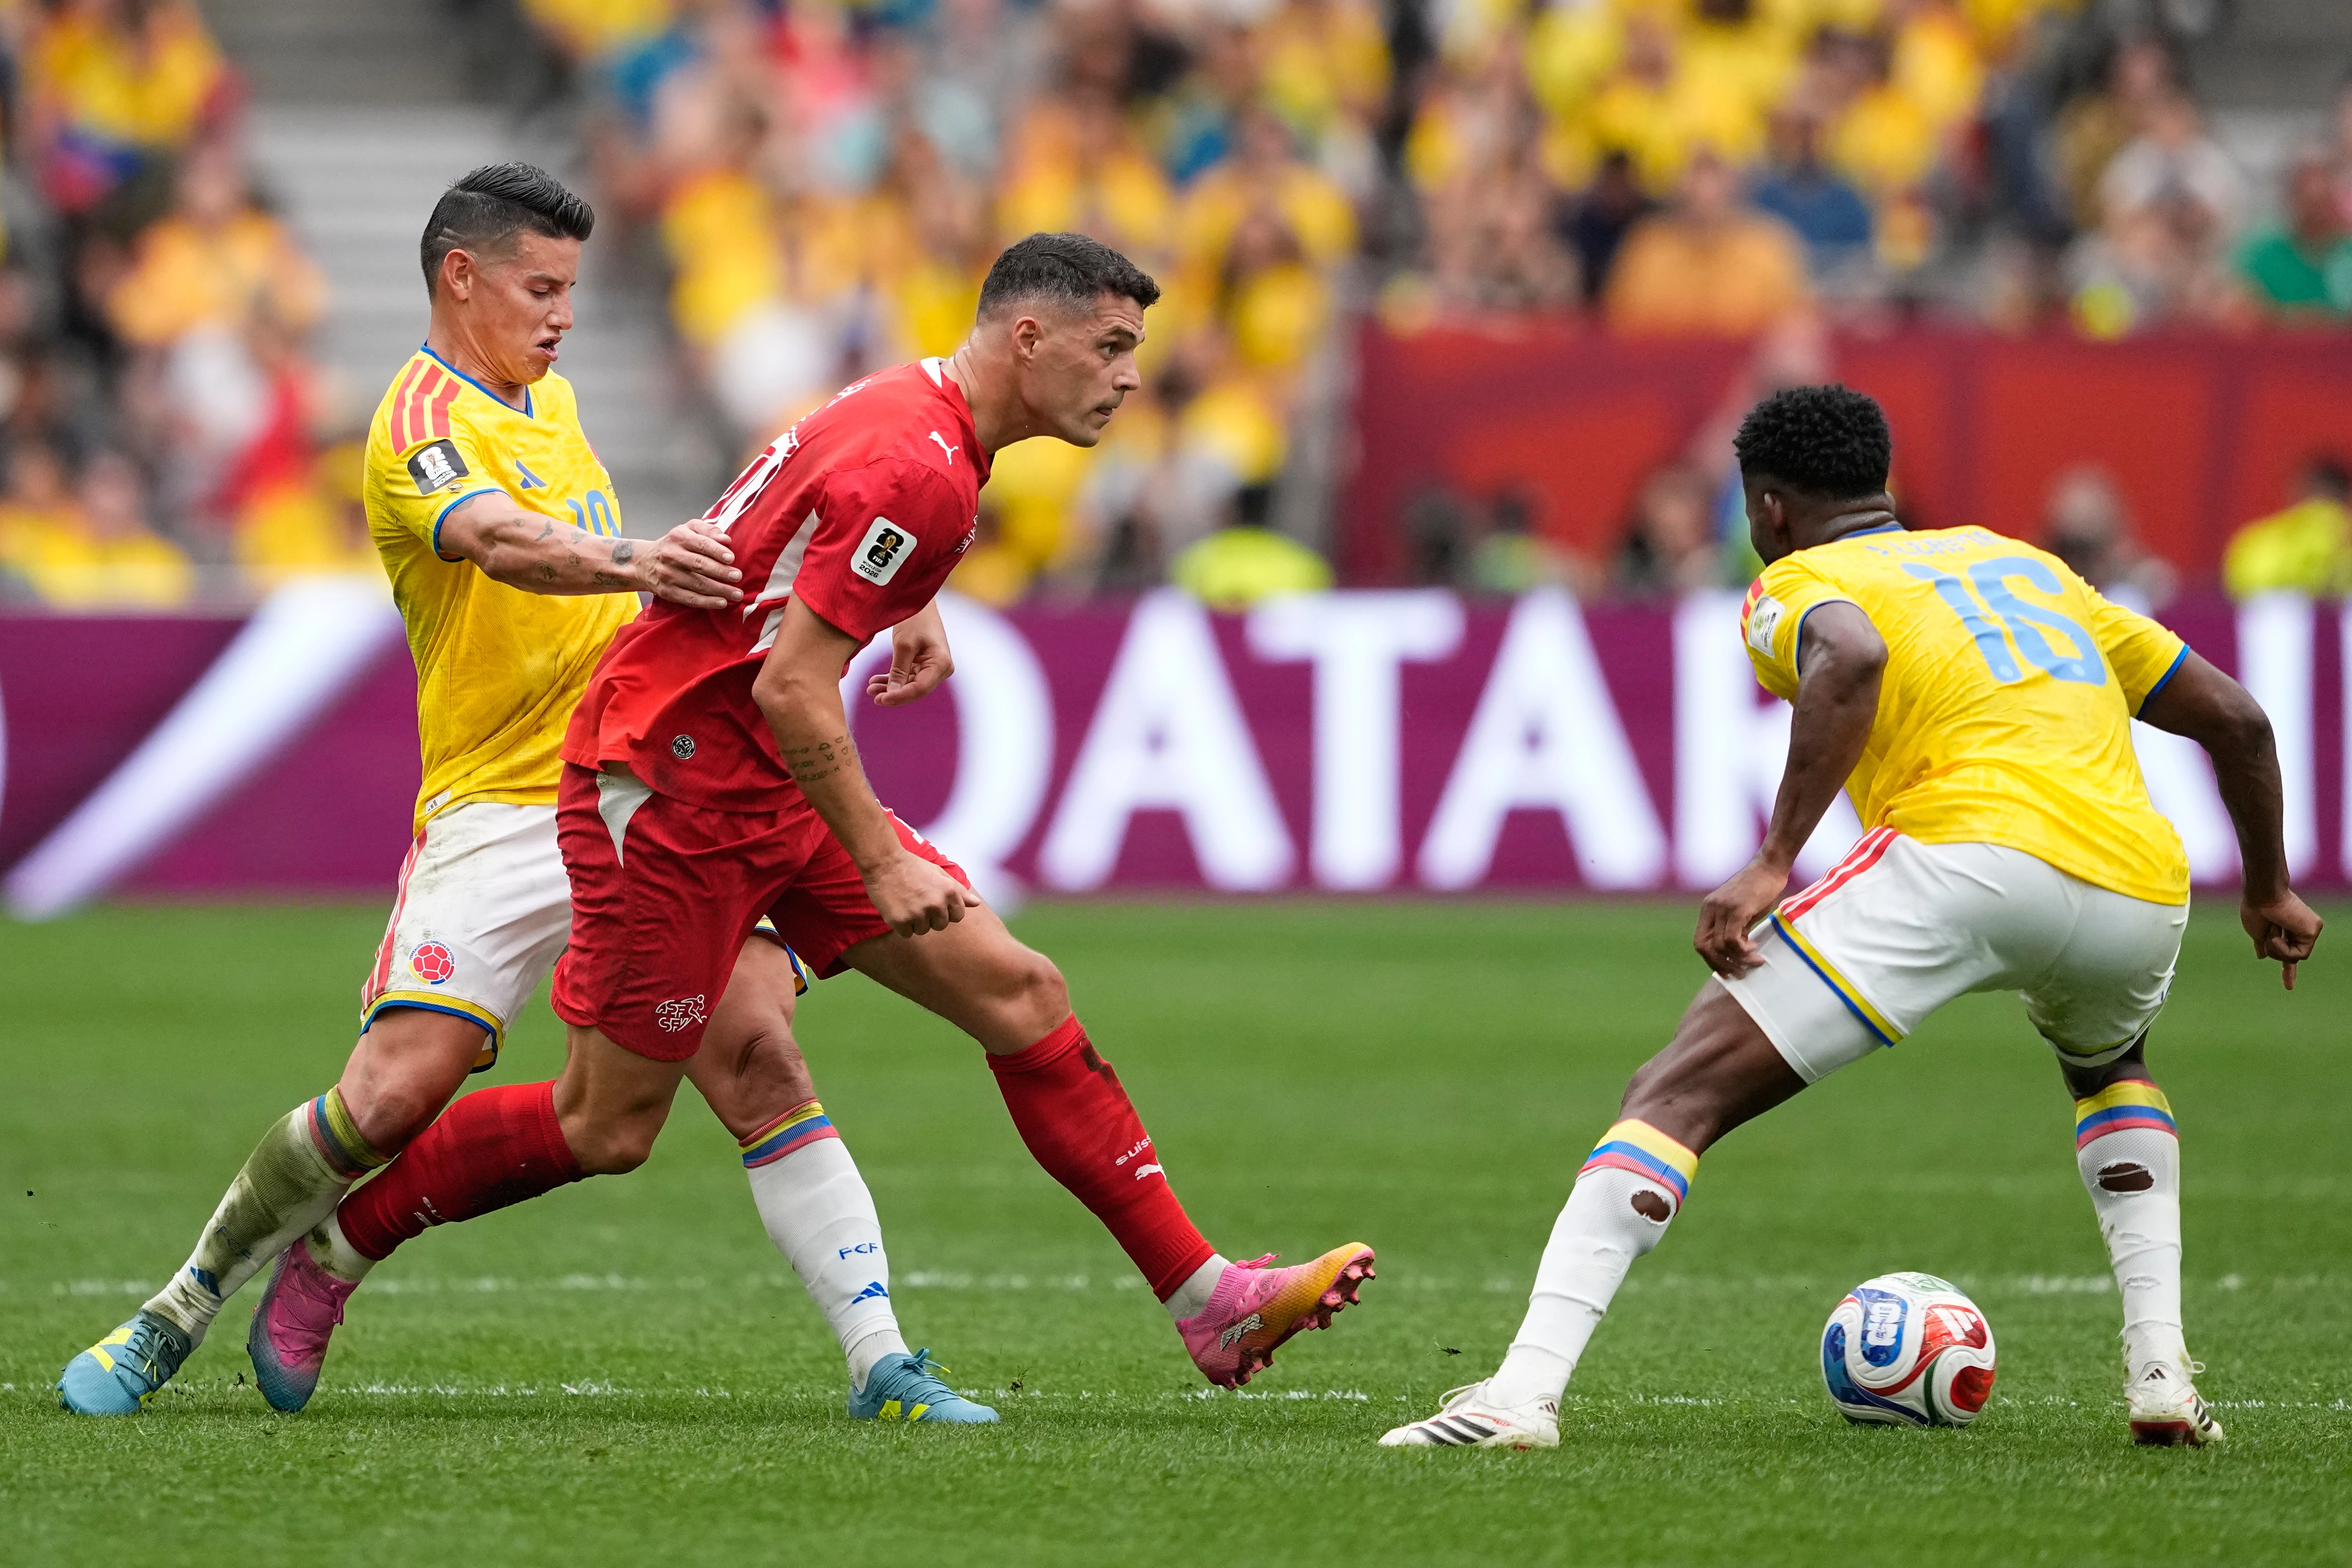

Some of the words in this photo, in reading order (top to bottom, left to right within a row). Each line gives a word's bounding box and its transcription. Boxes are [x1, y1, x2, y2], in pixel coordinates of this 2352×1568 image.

[433, 471, 457, 488] 2026
[862, 560, 876, 571] WORLD
[872, 555, 883, 565] FIFA
[859, 564, 879, 578] 2026
[1900, 556, 2106, 686] 16
[839, 1243, 878, 1260] FCF
